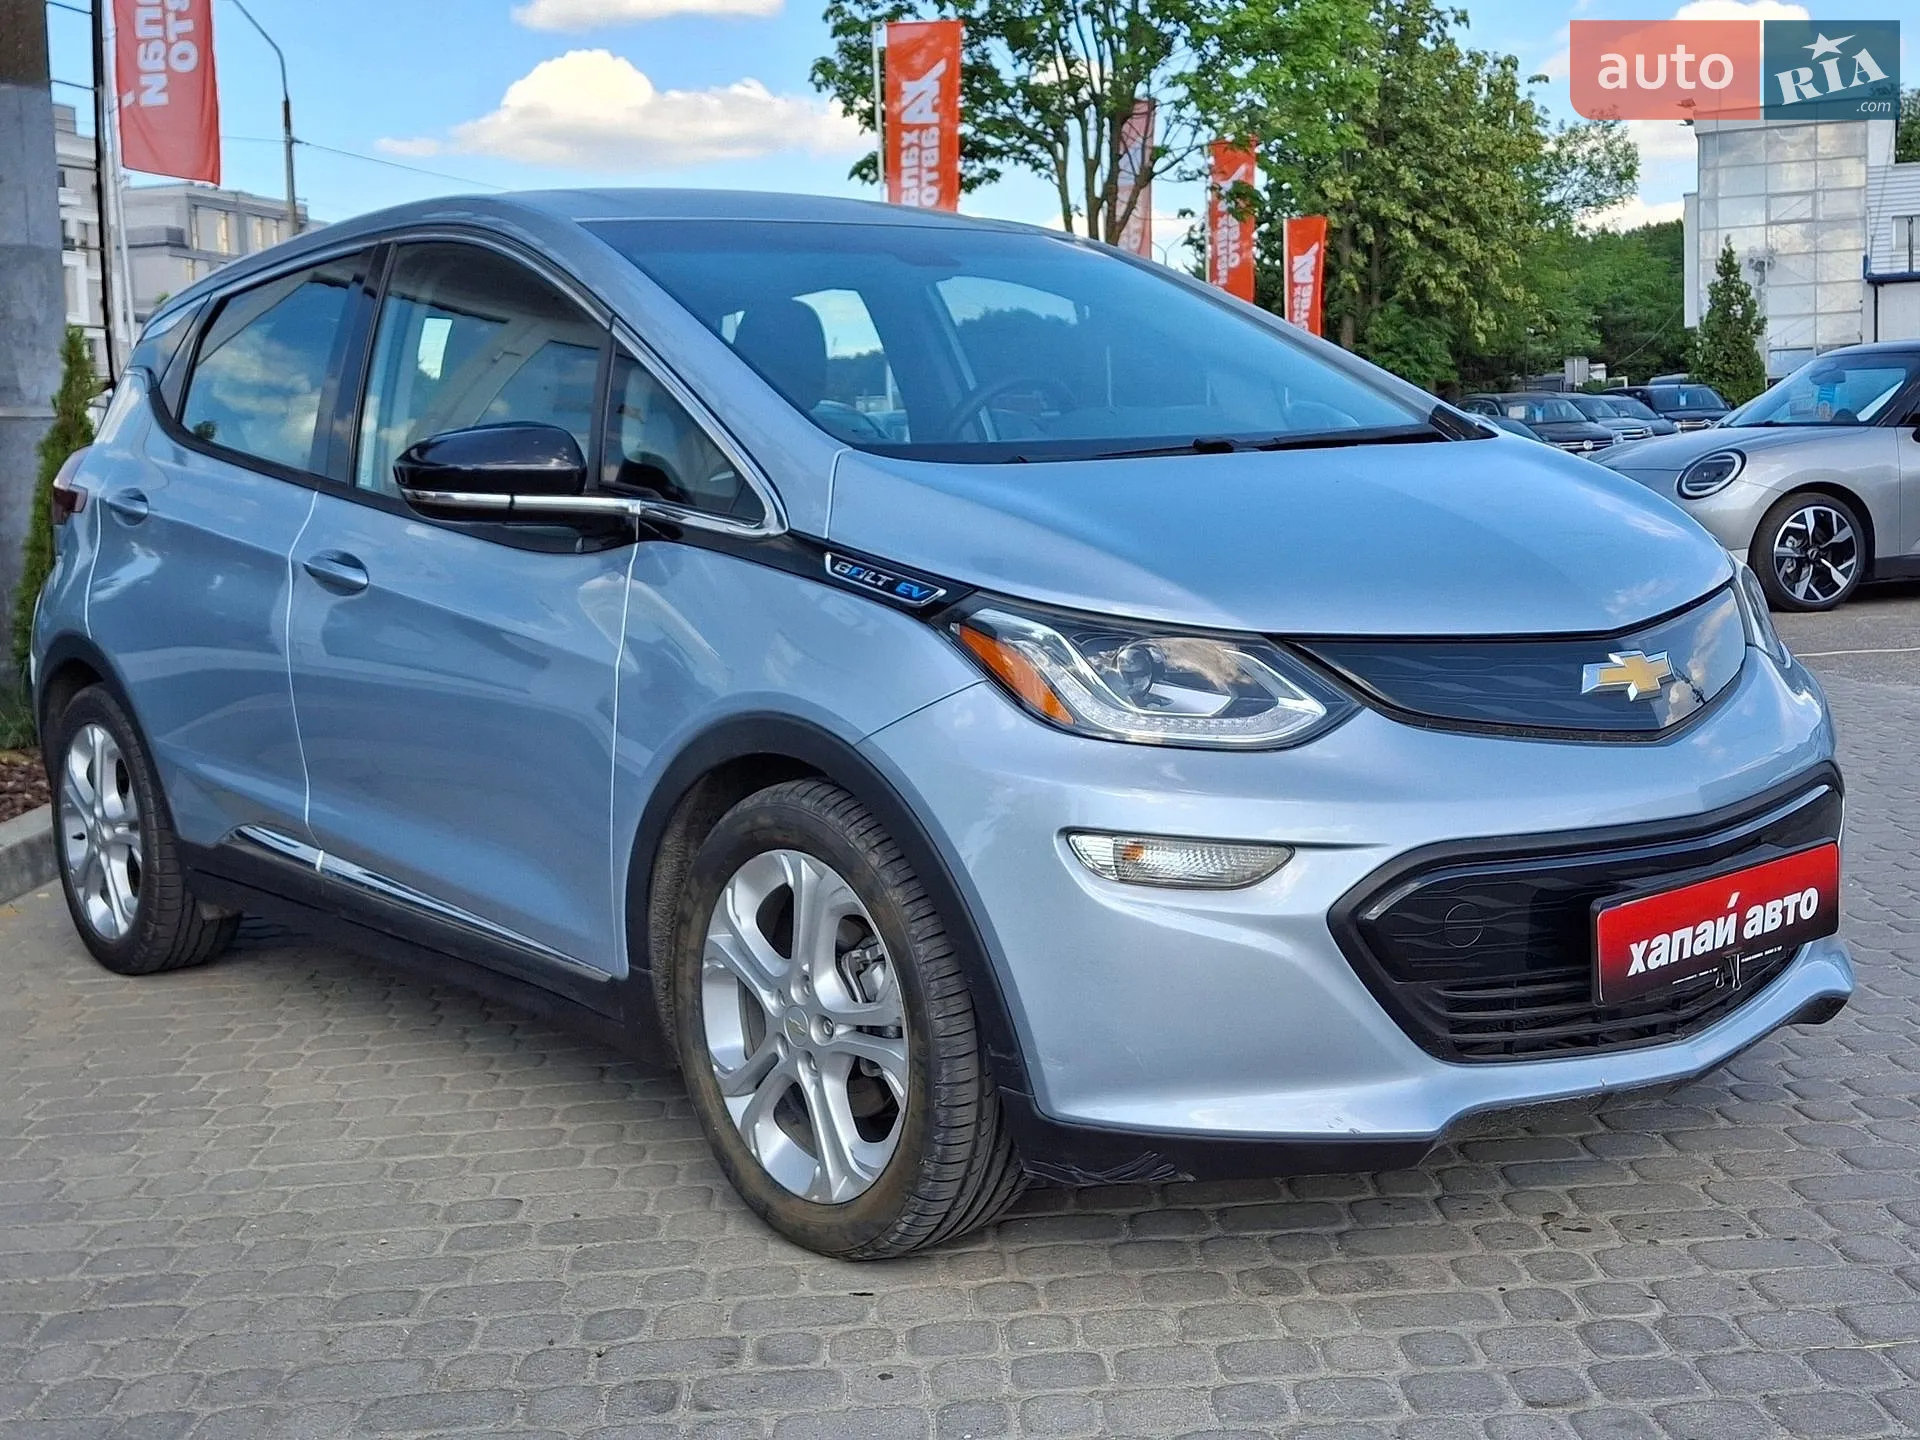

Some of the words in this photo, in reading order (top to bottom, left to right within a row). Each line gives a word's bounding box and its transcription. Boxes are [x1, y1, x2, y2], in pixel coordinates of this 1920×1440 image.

[833, 561, 894, 586] BOLT
[895, 581, 932, 598] EV
[1628, 892, 1741, 977] хапай
[1743, 887, 1819, 940] авто
